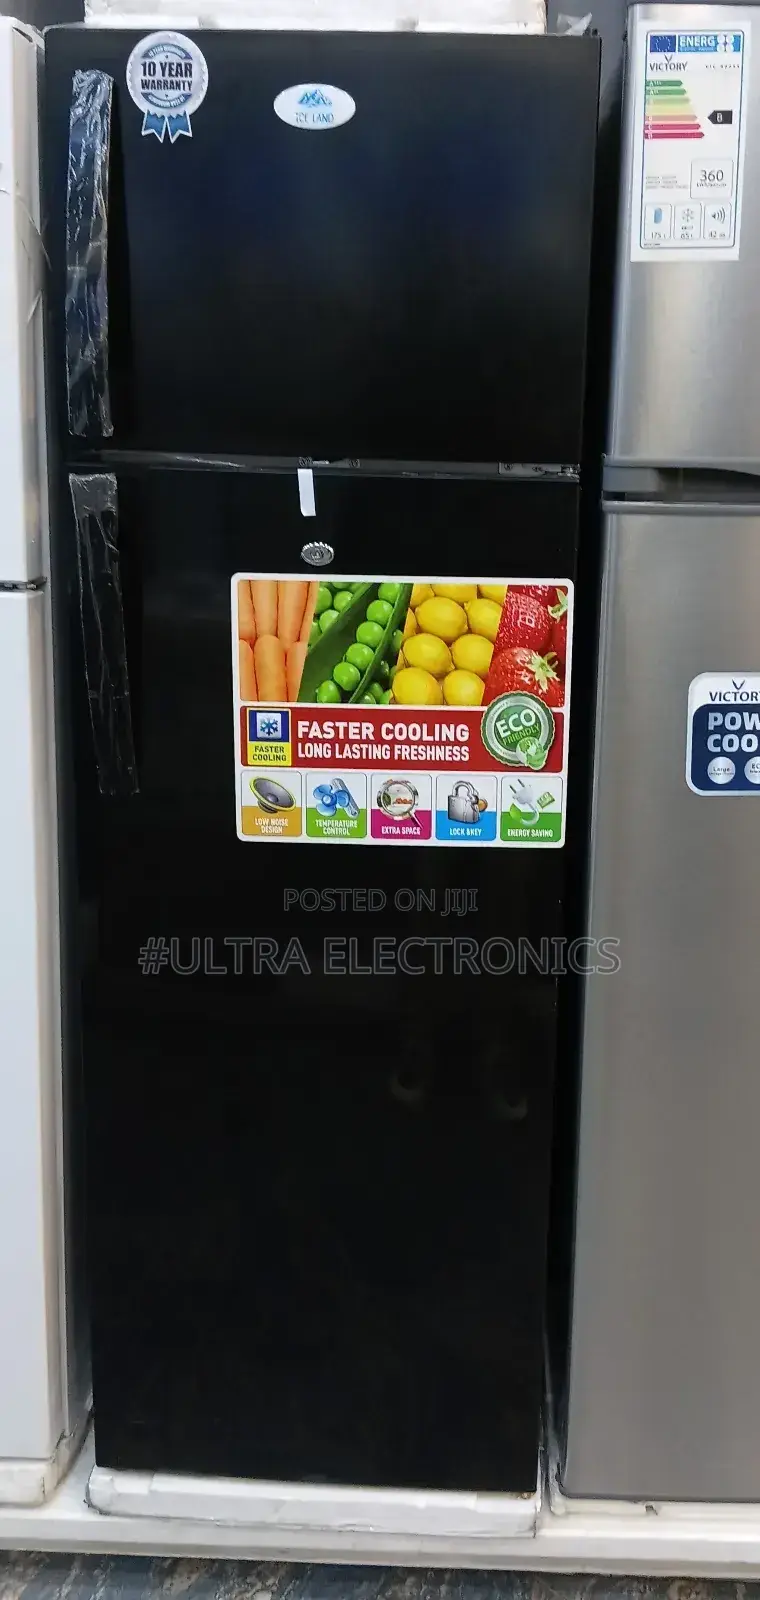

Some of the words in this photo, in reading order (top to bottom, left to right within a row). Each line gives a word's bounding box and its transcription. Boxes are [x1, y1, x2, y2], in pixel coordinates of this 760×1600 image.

[680, 35, 716, 47] ENERG
[141, 61, 156, 77] 10
[159, 61, 193, 78] YEAR
[649, 61, 688, 71] VICTORY
[141, 79, 193, 91] WARRANTY
[312, 112, 337, 124] LAND
[700, 169, 724, 182] 360
[496, 708, 536, 738] ECO
[297, 720, 375, 740] FASTER
[381, 722, 470, 742] COOLING
[502, 722, 540, 746] FRIENDLY
[254, 745, 285, 754] FASTER
[297, 742, 332, 759] LONG
[335, 743, 390, 760] LASTING
[394, 745, 470, 762] FRESHNESS
[252, 753, 287, 762] COOLING
[255, 818, 270, 826] LOW
[271, 818, 289, 827] NOISE
[315, 819, 358, 828] TEMPERATURE
[261, 826, 283, 834] DESIGN
[323, 827, 350, 836] CONTROL
[381, 826, 401, 835] EXTRA
[401, 826, 421, 836] SPACE
[450, 827, 466, 836] LOCK
[507, 828, 530, 838] ENERGY
[531, 829, 554, 838] SAVING
